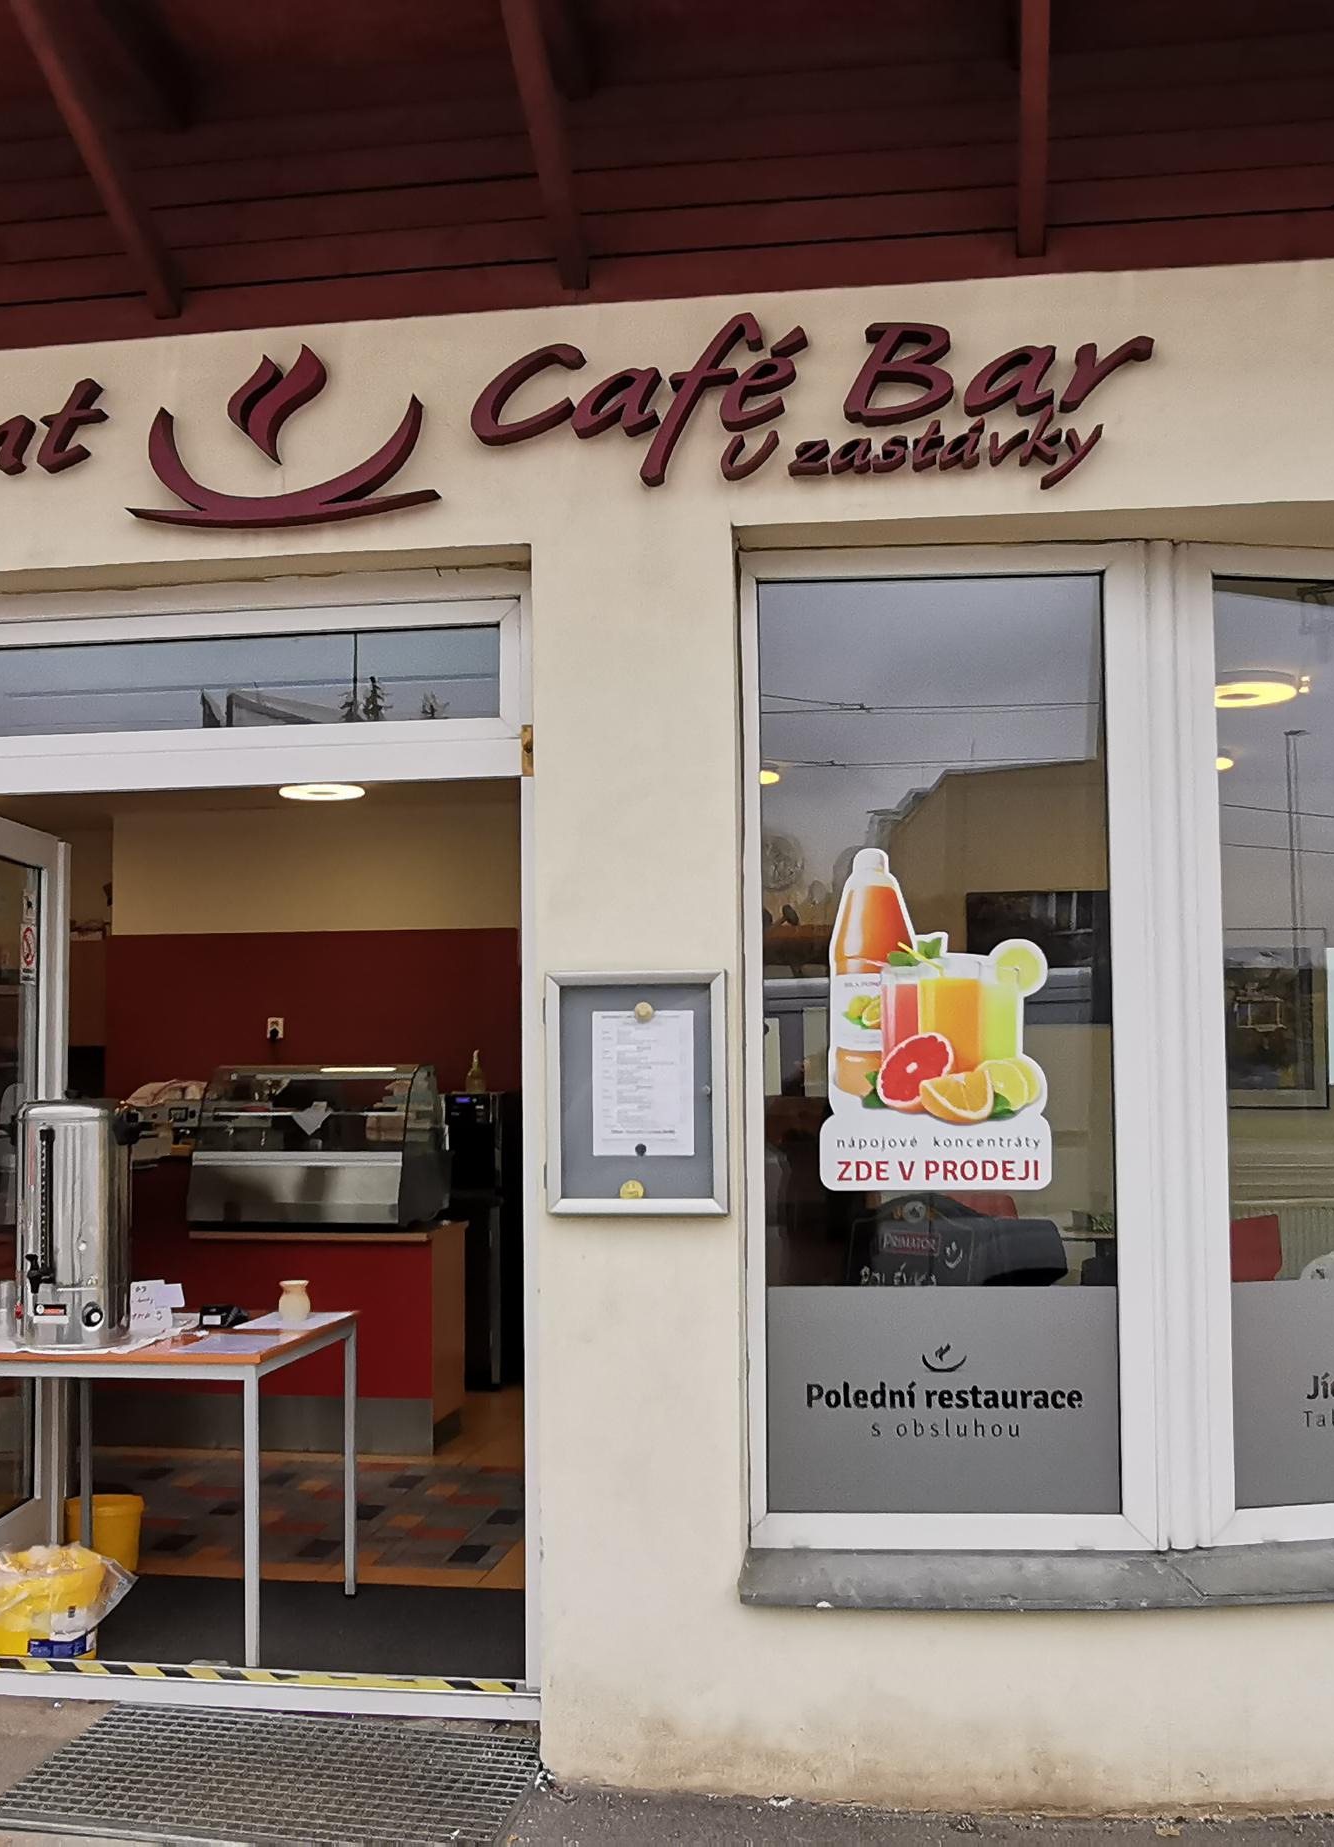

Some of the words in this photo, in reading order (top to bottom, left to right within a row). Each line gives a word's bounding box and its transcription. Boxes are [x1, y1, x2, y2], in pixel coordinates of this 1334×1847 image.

[469, 311, 809, 488] Café
[844, 321, 1155, 427] Bar
[788, 407, 1104, 490] zastávky
[836, 1135, 918, 1152] nápojové
[933, 1134, 1042, 1152] koncentráty
[836, 1161, 890, 1182] ZDE
[898, 1161, 916, 1181] V
[924, 1160, 1040, 1182] PRODEJI
[805, 1380, 916, 1410] Polední
[925, 1383, 1084, 1410] restaurace
[870, 1422, 881, 1438] s
[896, 1418, 1021, 1439] obsluhou
